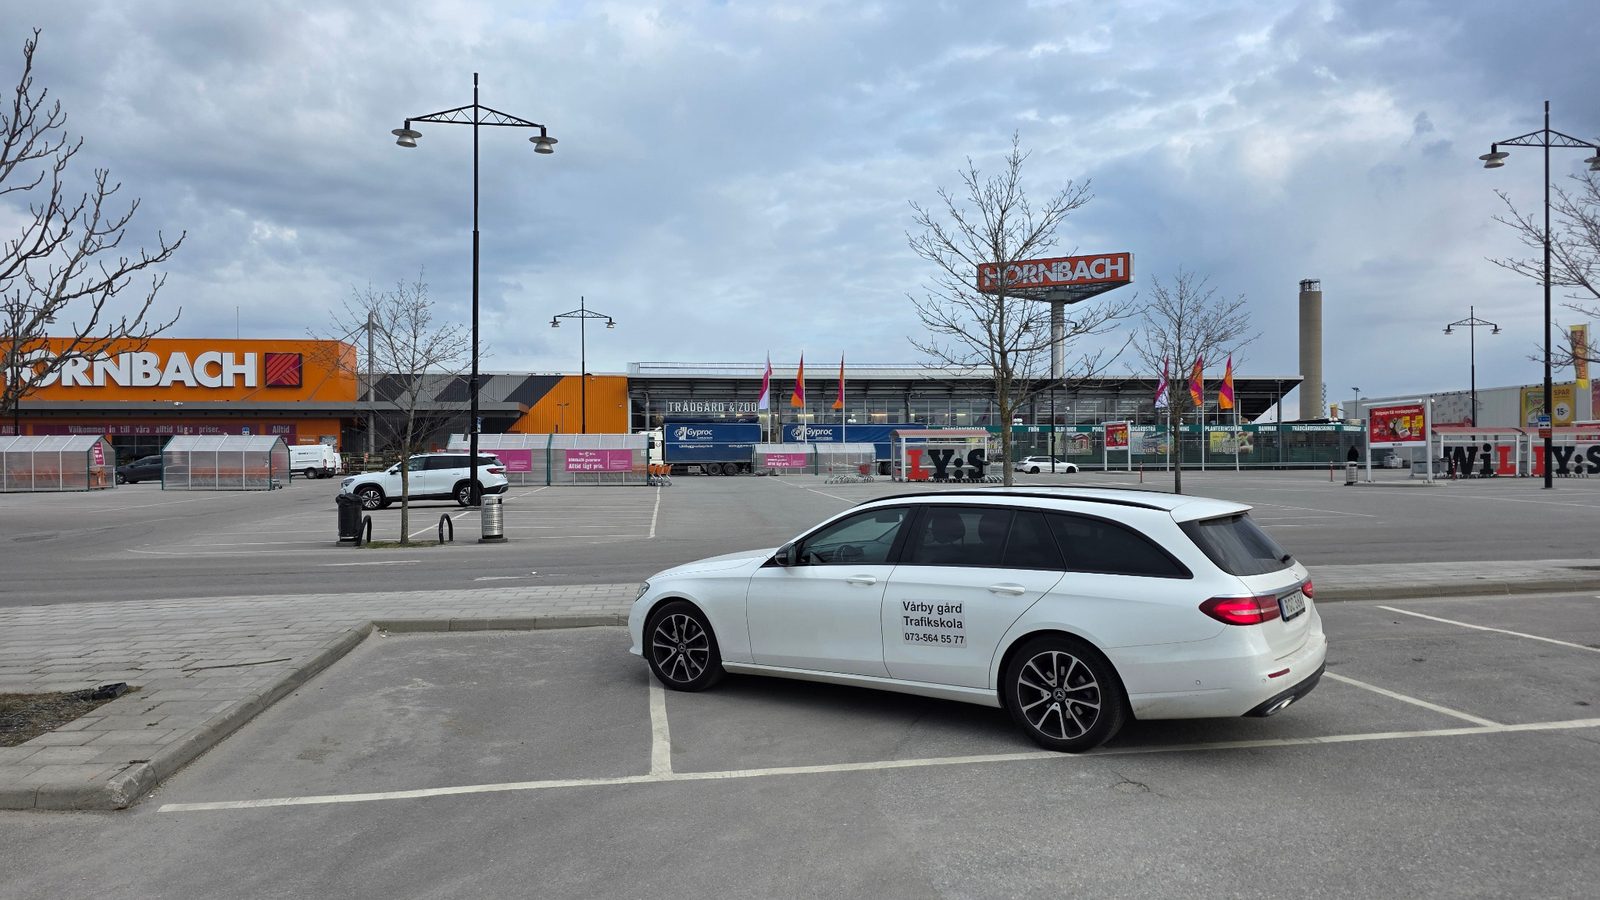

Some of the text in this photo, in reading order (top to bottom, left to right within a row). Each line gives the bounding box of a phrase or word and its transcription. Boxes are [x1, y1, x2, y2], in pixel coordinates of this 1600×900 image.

[984, 257, 1124, 287] HORNBACH
[1553, 388, 1570, 396] SPAR
[668, 400, 757, 412] TRÄDGÅRD & ZOO
[68, 425, 106, 434] Välkommen
[120, 425, 130, 434] till
[135, 425, 150, 434] våra
[155, 425, 173, 434] alltid
[177, 425, 194, 435] låga
[198, 426, 221, 435] priser.
[272, 425, 290, 434] Alltid
[687, 428, 713, 437] Gyproc
[805, 427, 833, 437] Gyproc
[902, 601, 963, 615] Vårby gård
[903, 616, 963, 629] Trafikskola
[904, 632, 964, 644] 073-564 55 77
